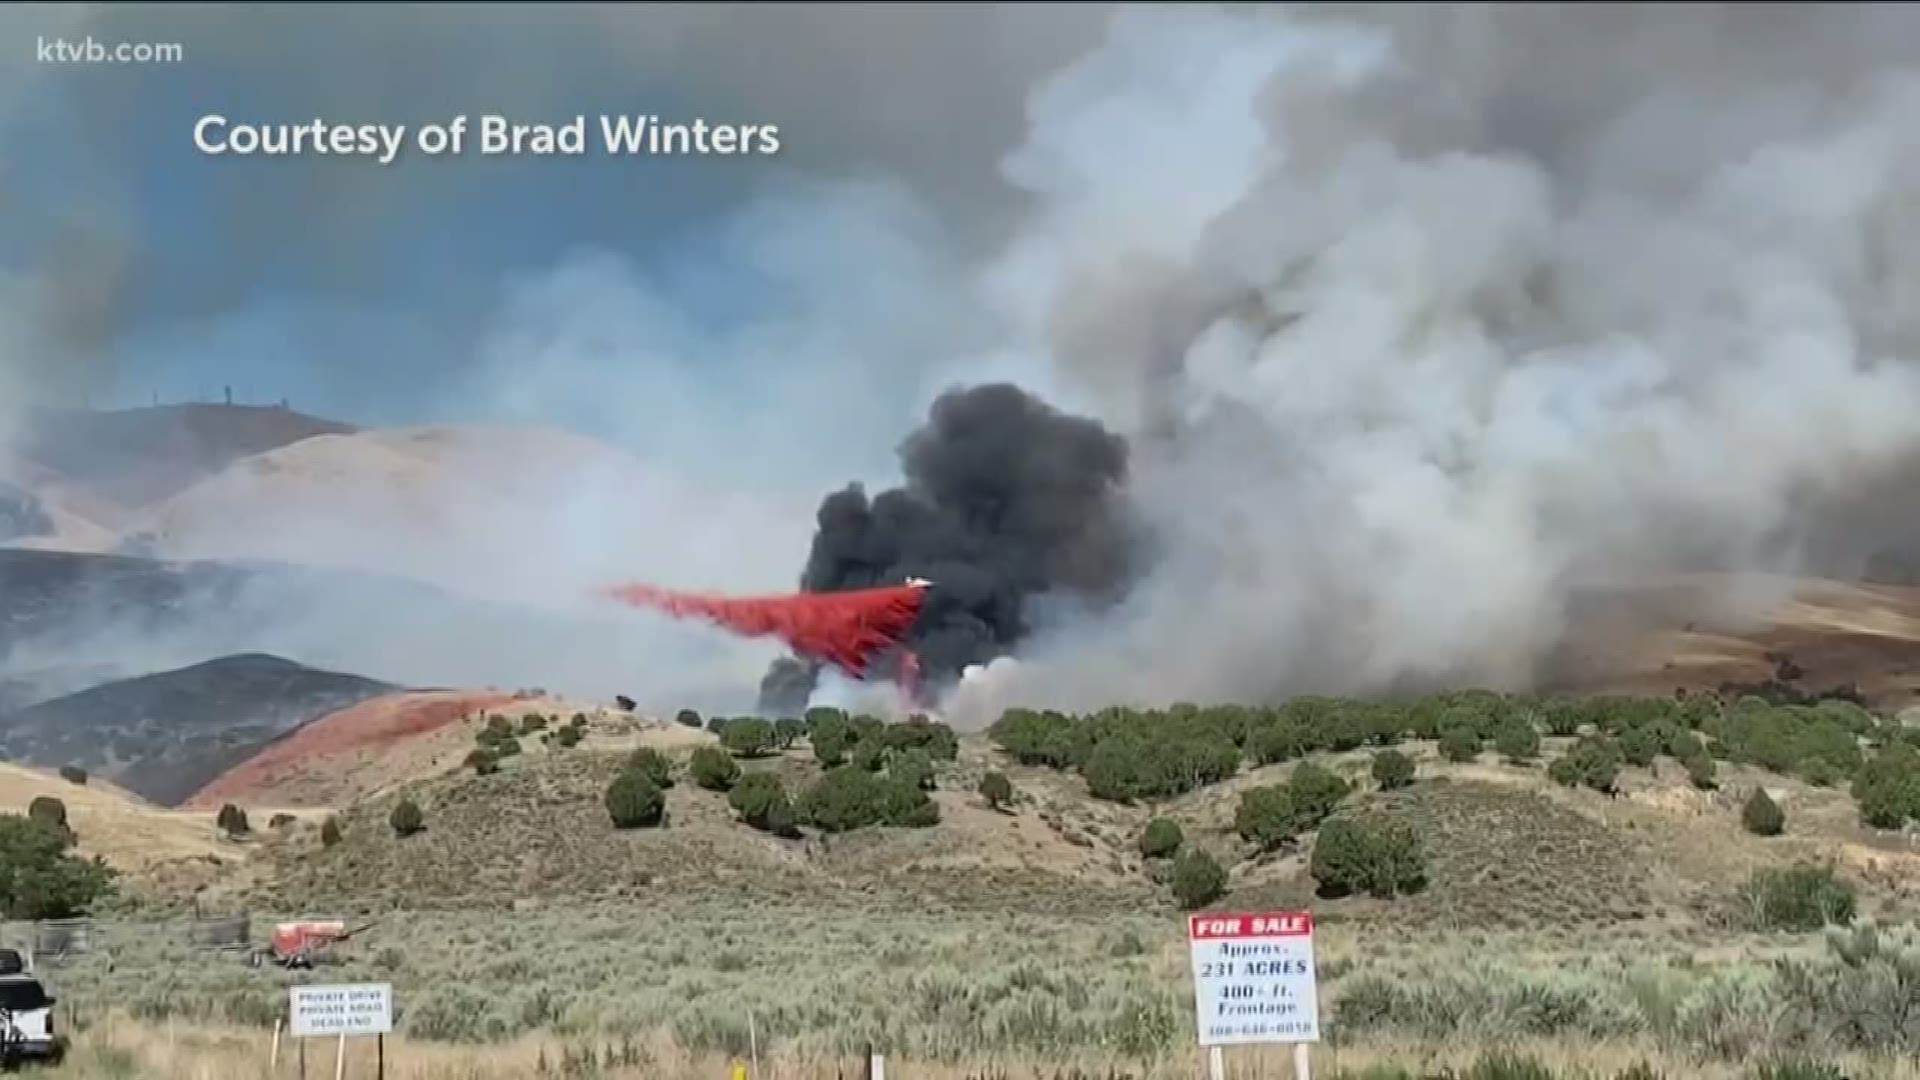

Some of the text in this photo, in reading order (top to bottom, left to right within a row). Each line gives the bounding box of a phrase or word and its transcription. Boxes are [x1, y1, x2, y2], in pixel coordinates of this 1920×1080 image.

[1196, 916, 1306, 935] FOR SALE
[1220, 943, 1288, 957] Approx.
[1202, 959, 1308, 977] 231 ACRES
[298, 990, 382, 1002] PRIVATE DRIVE
[299, 1004, 345, 1014] PRIVATE
[1219, 1002, 1296, 1016] Frontage
[311, 1017, 345, 1028] DEAD
